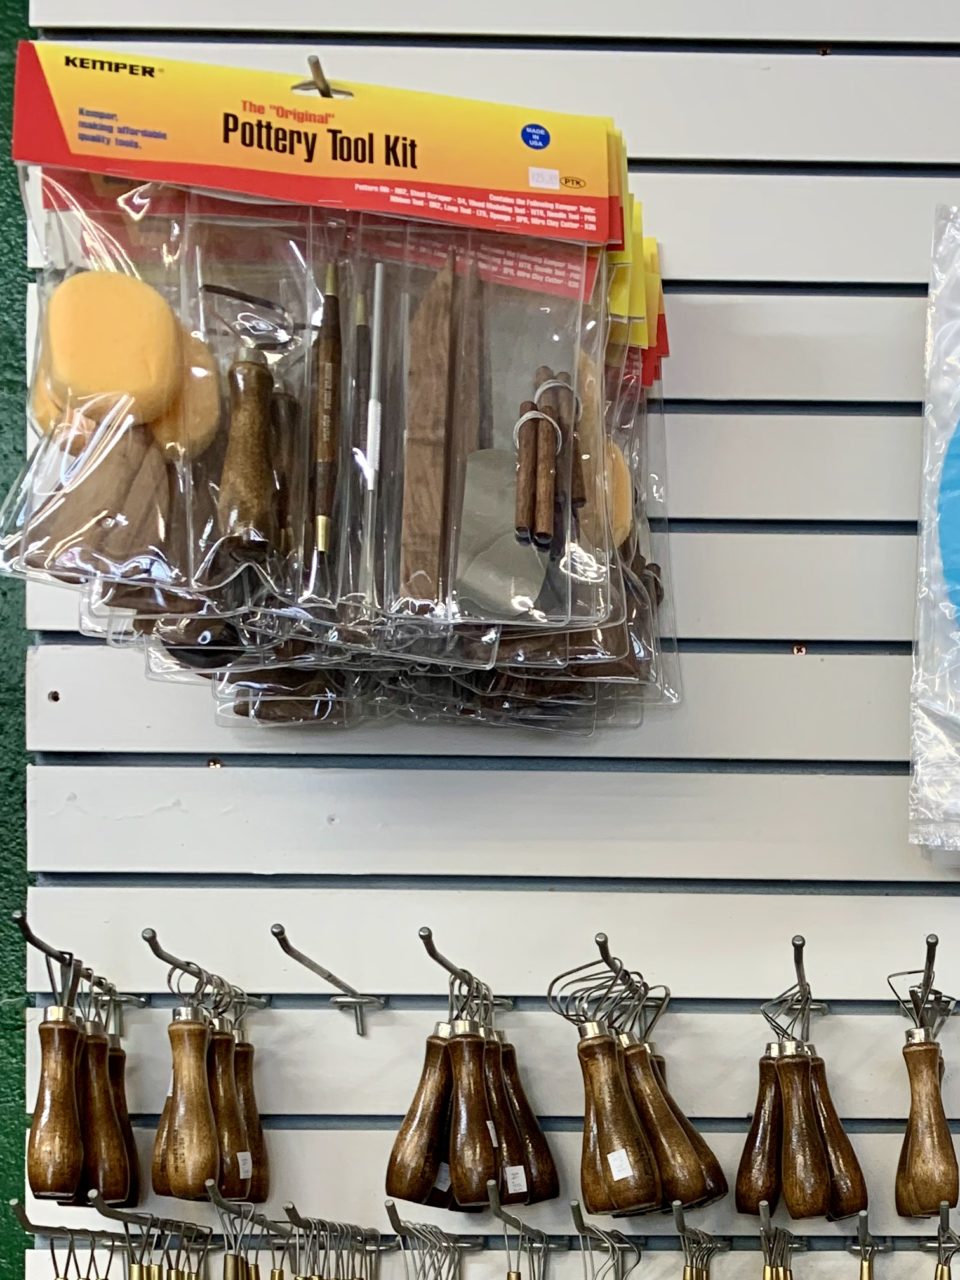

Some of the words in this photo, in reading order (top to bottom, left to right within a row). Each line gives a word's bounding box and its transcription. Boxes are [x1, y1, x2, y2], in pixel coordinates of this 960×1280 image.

[65, 55, 155, 78] KEMPER
[241, 100, 265, 115] The
[223, 112, 317, 163] Pottery
[327, 128, 374, 165] Tool
[385, 134, 418, 169] Kit
[564, 178, 581, 186] PTK
